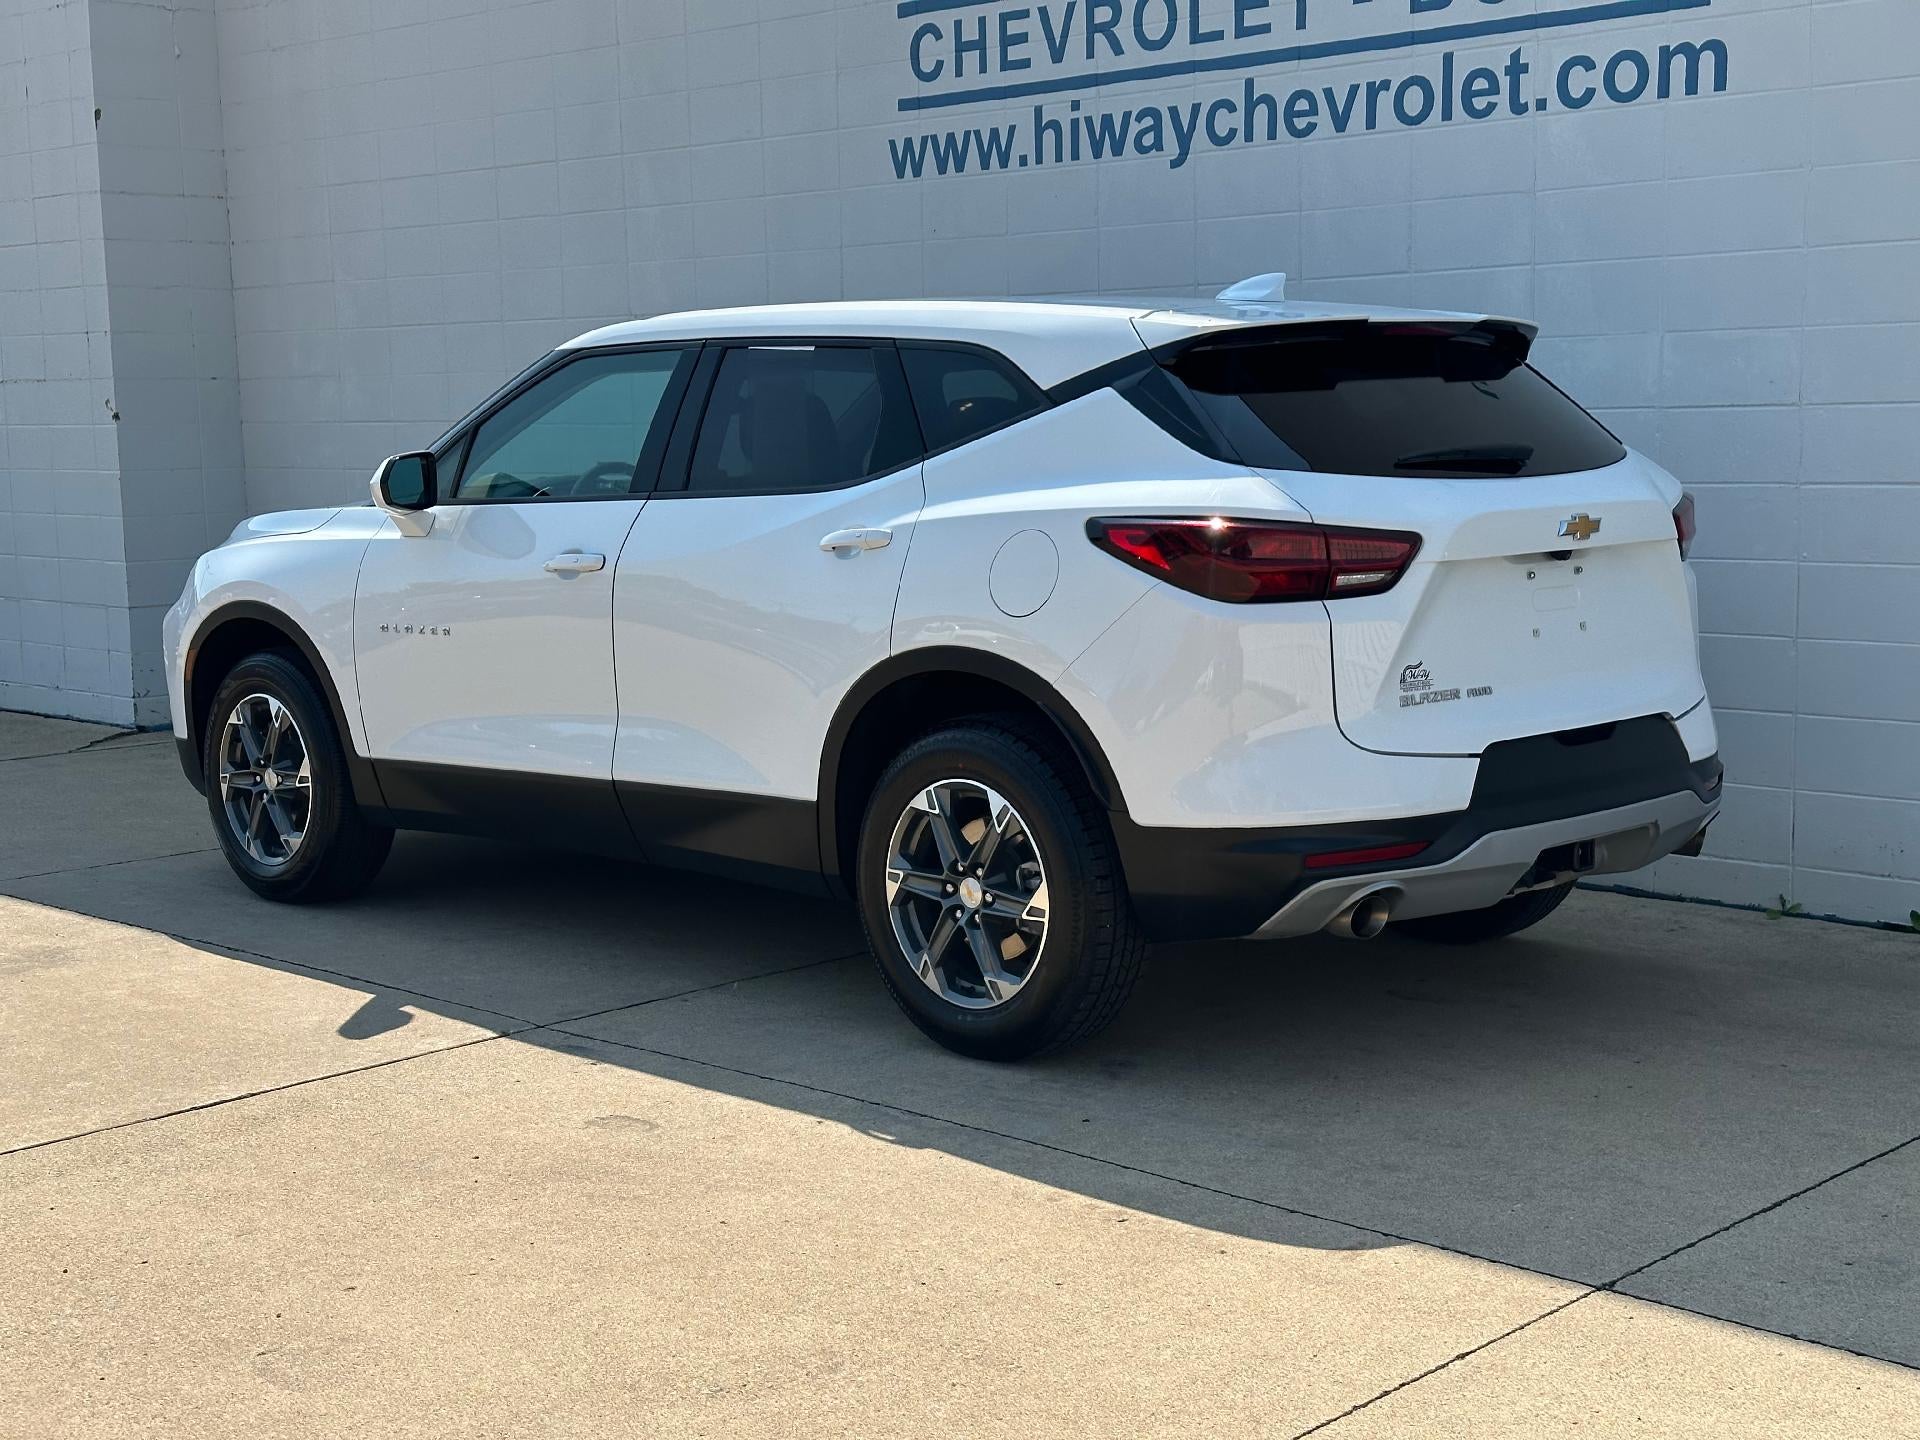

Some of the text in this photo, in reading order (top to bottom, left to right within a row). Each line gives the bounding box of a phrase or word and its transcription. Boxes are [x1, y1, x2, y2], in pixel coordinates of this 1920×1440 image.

[888, 38, 1728, 180] www.hiwaychevrolet.com
[1399, 688, 1461, 708] BLAZER
[1466, 686, 1493, 698] AWD
